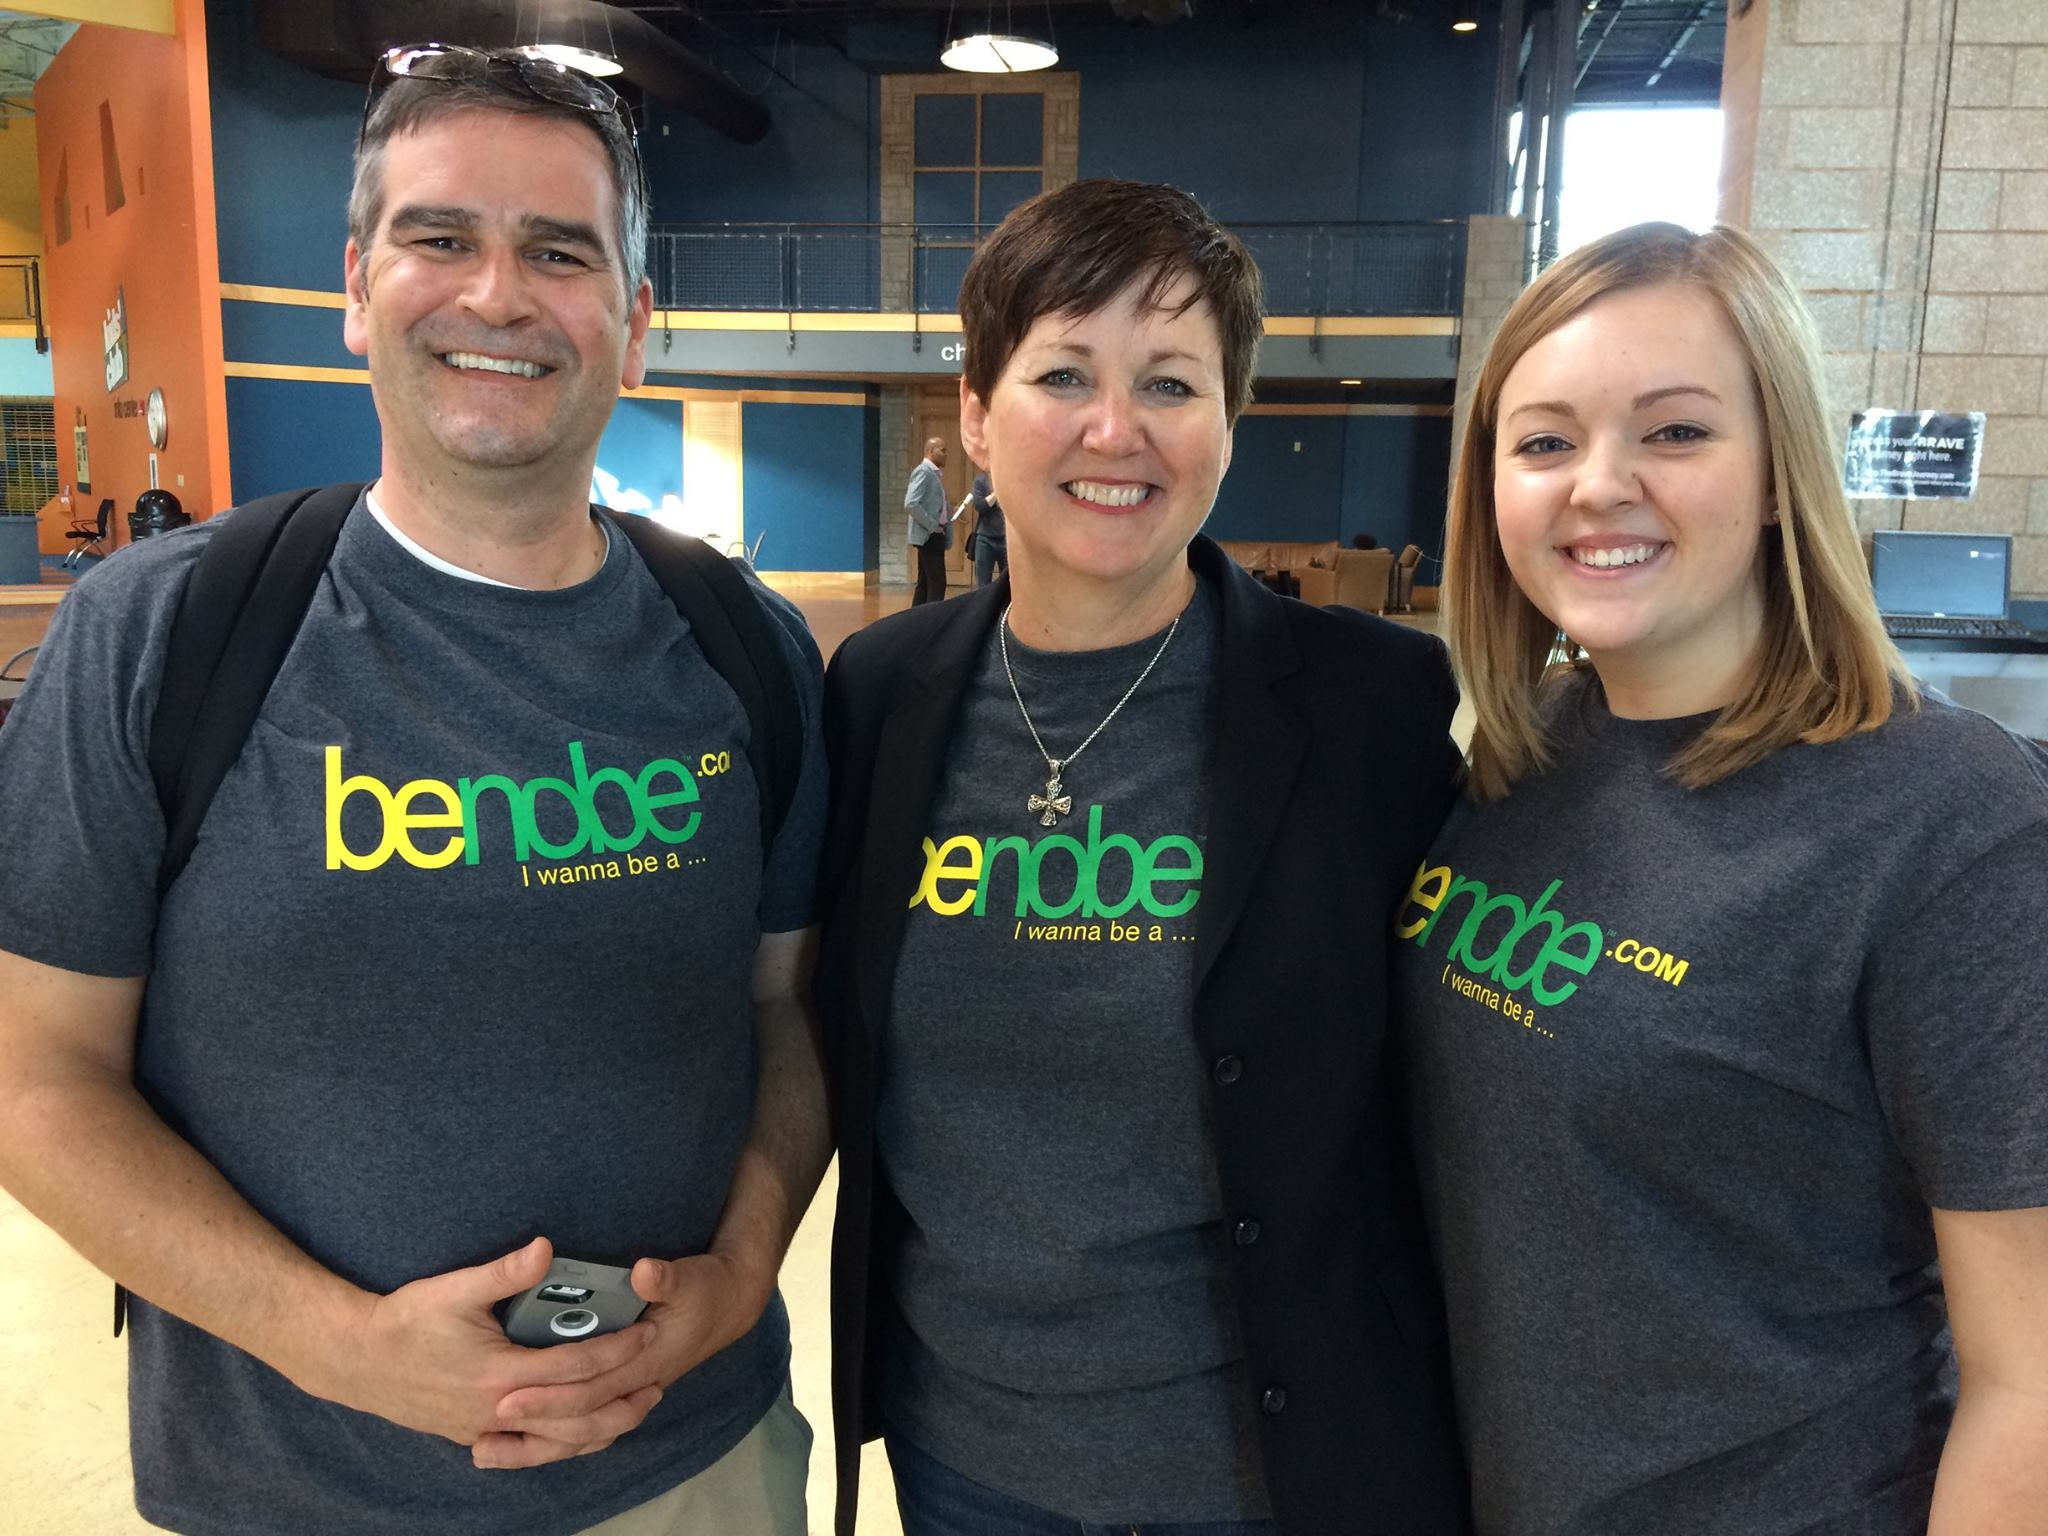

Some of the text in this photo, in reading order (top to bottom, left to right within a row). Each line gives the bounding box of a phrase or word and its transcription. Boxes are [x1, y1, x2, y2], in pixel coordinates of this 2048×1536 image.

[522, 865, 530, 887] I
[537, 860, 621, 886] wanna
[627, 853, 659, 876] be
[666, 852, 681, 870] a
[1014, 921, 1022, 940] I
[1028, 924, 1101, 942] wanna
[1110, 920, 1141, 942] be
[1148, 924, 1163, 942] a
[1394, 859, 1604, 1007] enobe
[1442, 964, 1451, 985] I
[1451, 973, 1500, 1011] wanna
[1503, 993, 1522, 1021] be
[1523, 1008, 1534, 1029] a
